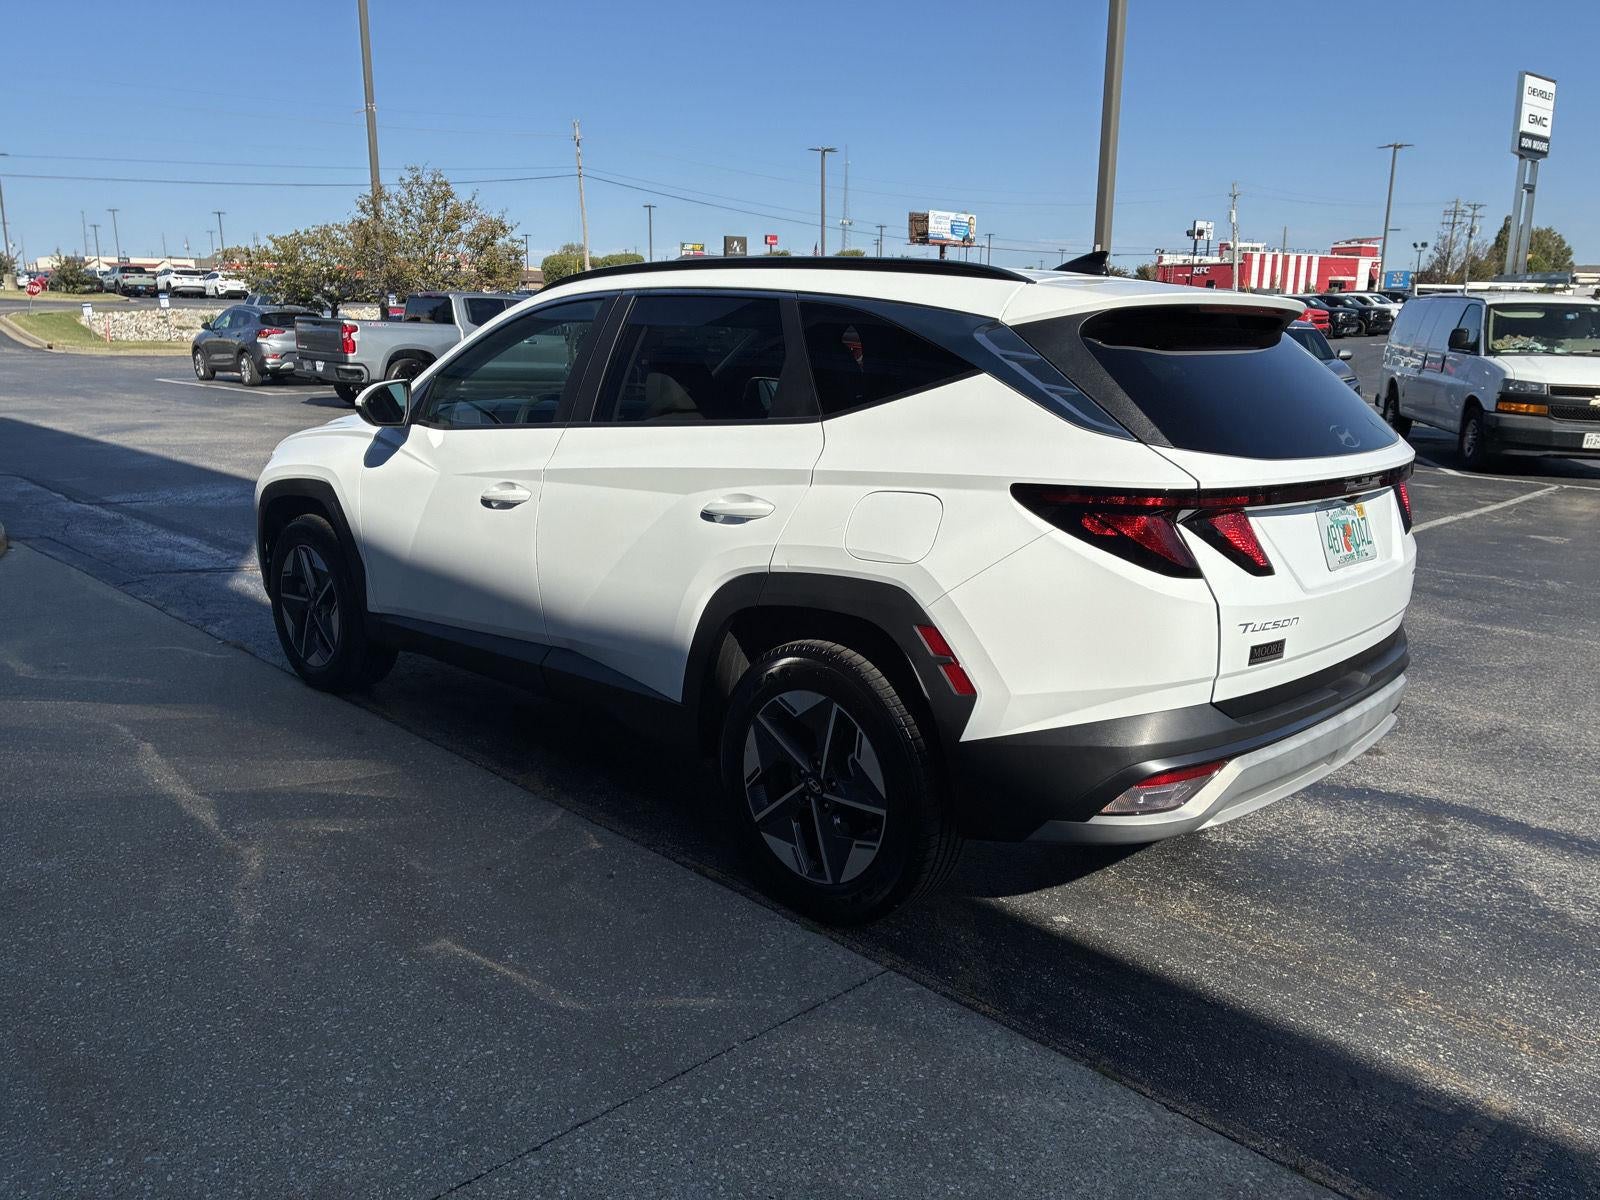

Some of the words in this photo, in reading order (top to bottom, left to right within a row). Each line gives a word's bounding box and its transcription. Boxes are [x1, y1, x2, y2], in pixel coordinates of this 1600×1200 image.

[1528, 86, 1554, 101] CHEVROLET
[1528, 113, 1548, 128] GMC
[1192, 266, 1211, 275] KFC
[26, 284, 41, 293] STOP
[1252, 642, 1283, 658] MOORE
